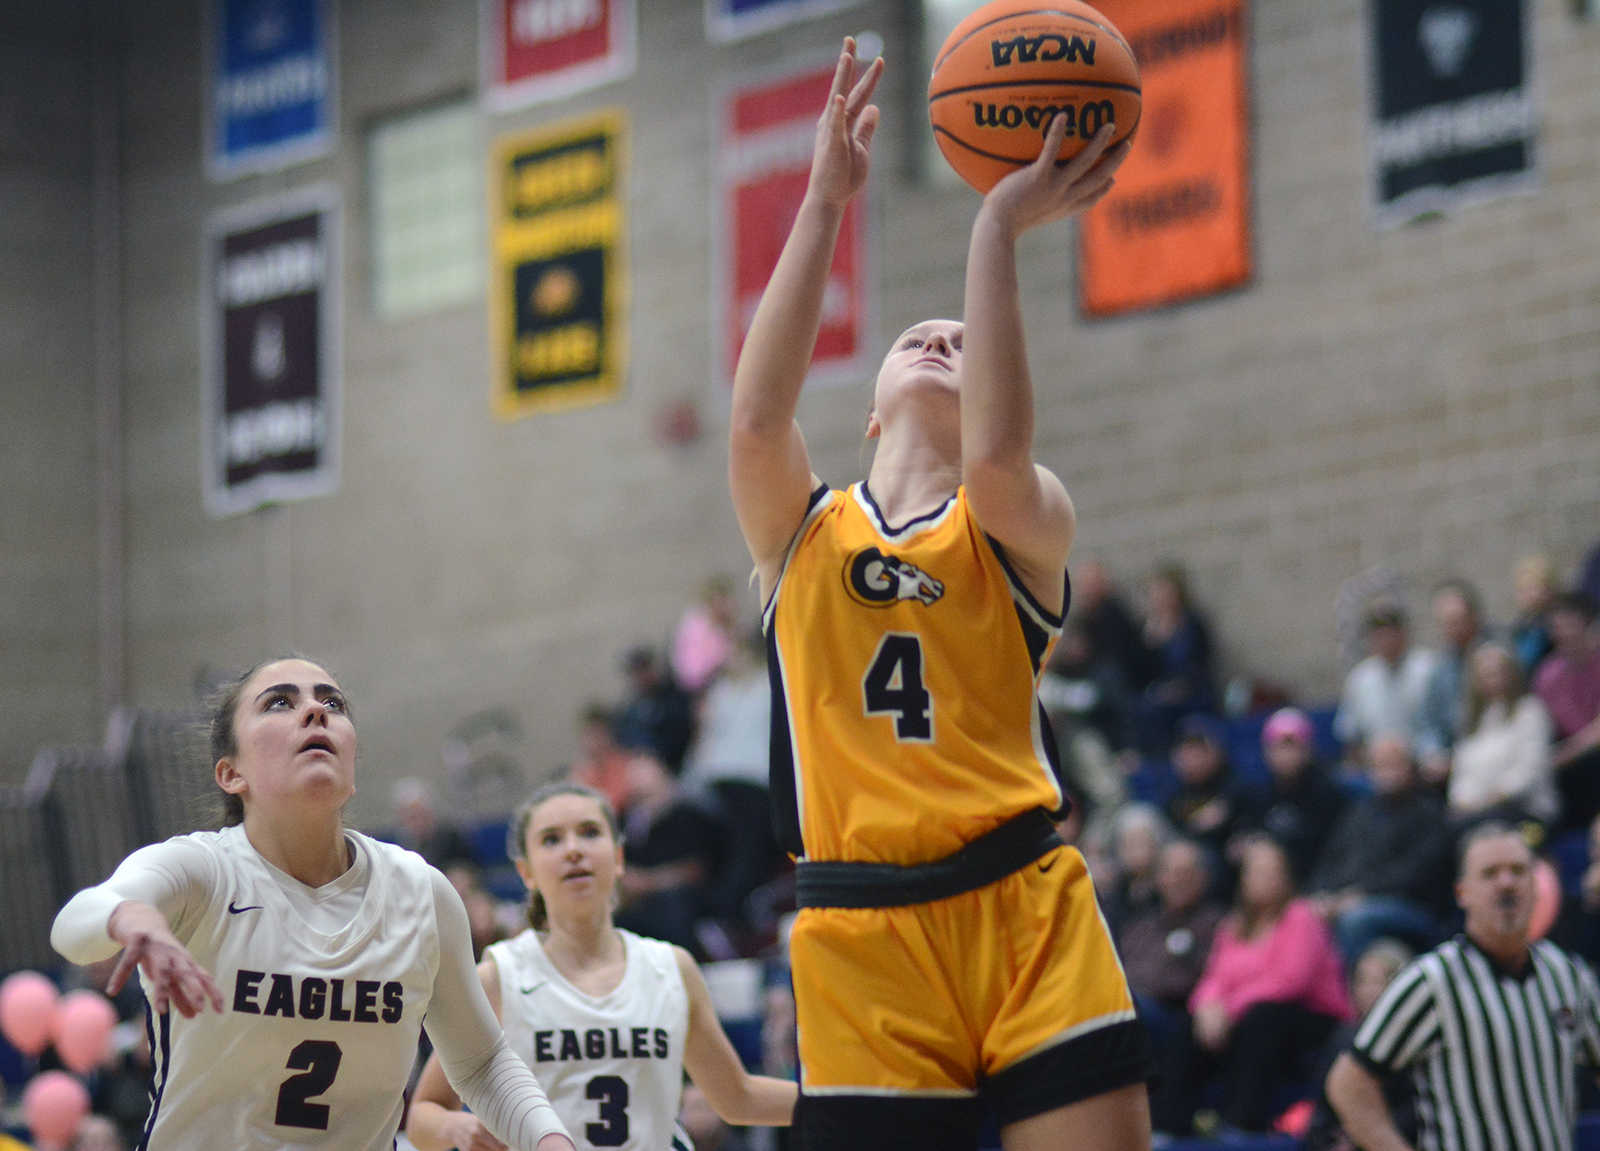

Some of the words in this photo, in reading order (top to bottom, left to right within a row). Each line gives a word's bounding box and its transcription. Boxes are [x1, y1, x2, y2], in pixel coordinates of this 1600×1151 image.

[990, 34, 1096, 67] NCAA
[973, 99, 1116, 141] Wilson
[862, 631, 934, 744] 4
[233, 969, 404, 1024] EAGLES
[534, 1027, 669, 1063] EAGLES
[274, 1039, 343, 1131] 2
[585, 1075, 630, 1147] 3
